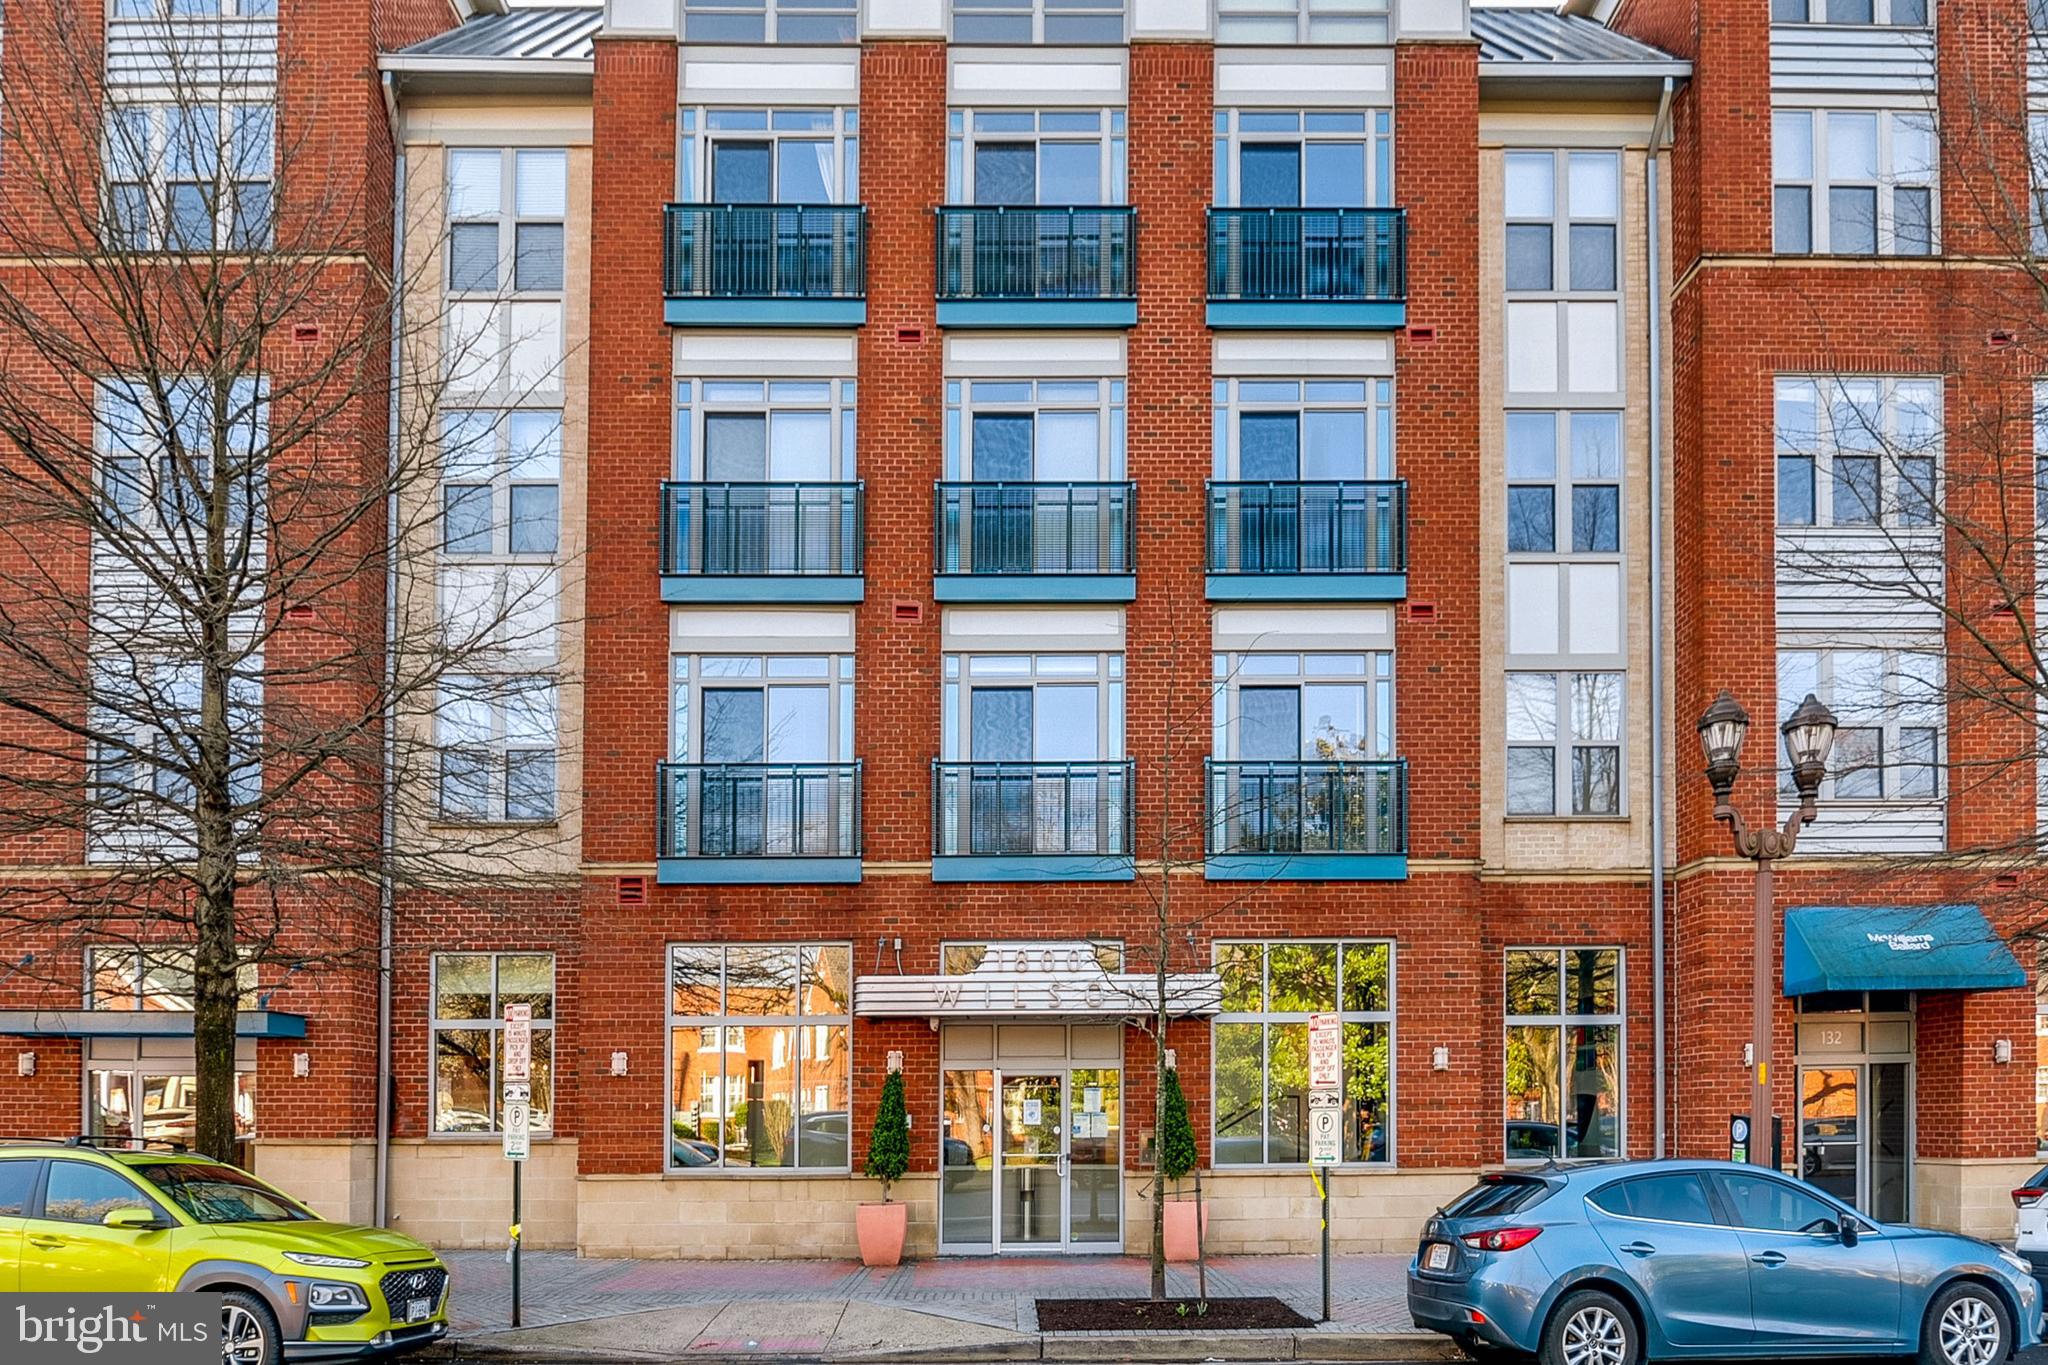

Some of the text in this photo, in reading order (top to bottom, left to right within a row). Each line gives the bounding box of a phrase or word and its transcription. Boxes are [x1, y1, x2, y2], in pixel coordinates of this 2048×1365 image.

[998, 948, 1081, 973] 1800
[932, 982, 1148, 1009] WILSON
[1319, 1017, 1338, 1025] PARKING
[1821, 1031, 1842, 1045] 132
